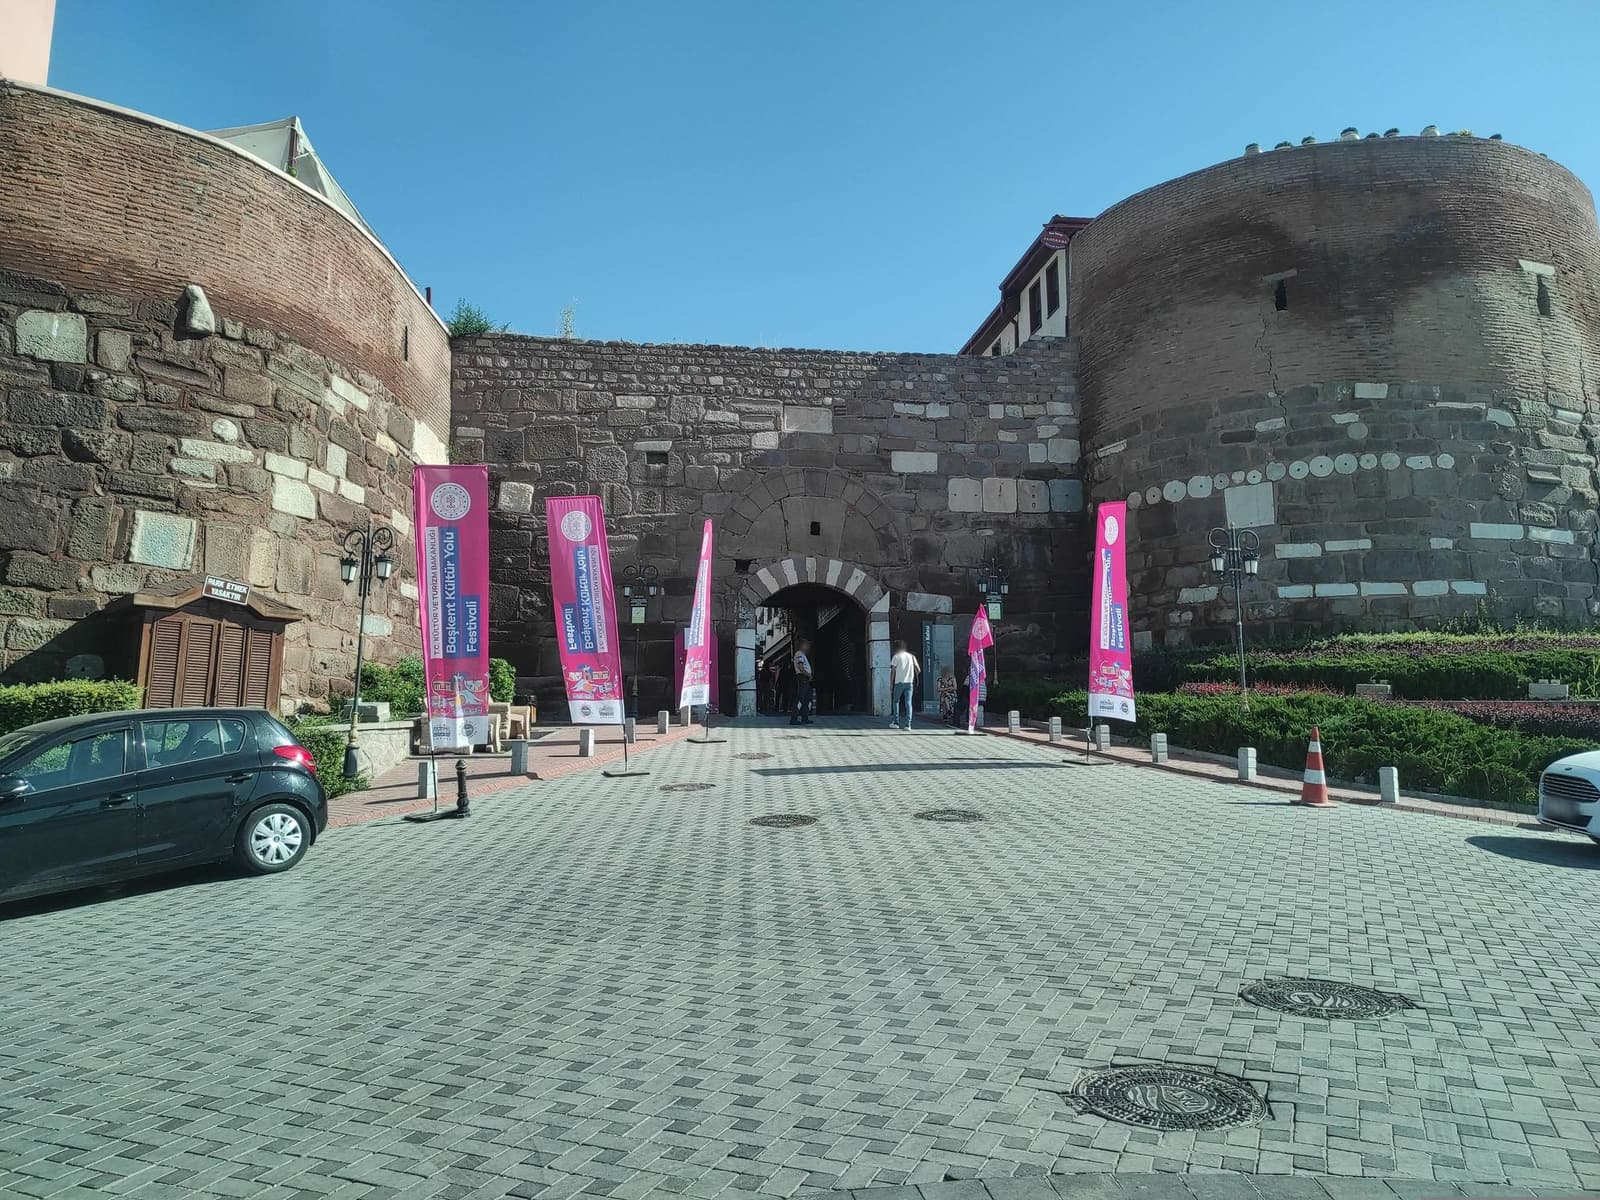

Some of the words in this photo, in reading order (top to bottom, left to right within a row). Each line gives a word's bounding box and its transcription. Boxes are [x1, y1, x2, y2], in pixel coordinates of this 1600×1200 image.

[428, 529, 437, 571] BAKANLIĞI
[443, 531, 455, 558] Yolu
[430, 571, 439, 600] TURİZM
[444, 560, 456, 600] Kültür
[432, 601, 439, 611] VE
[431, 613, 440, 642] KÜLTÜR
[446, 602, 460, 654] Başkent
[465, 601, 478, 652] Festivali
[1115, 608, 1124, 649] Festivali
